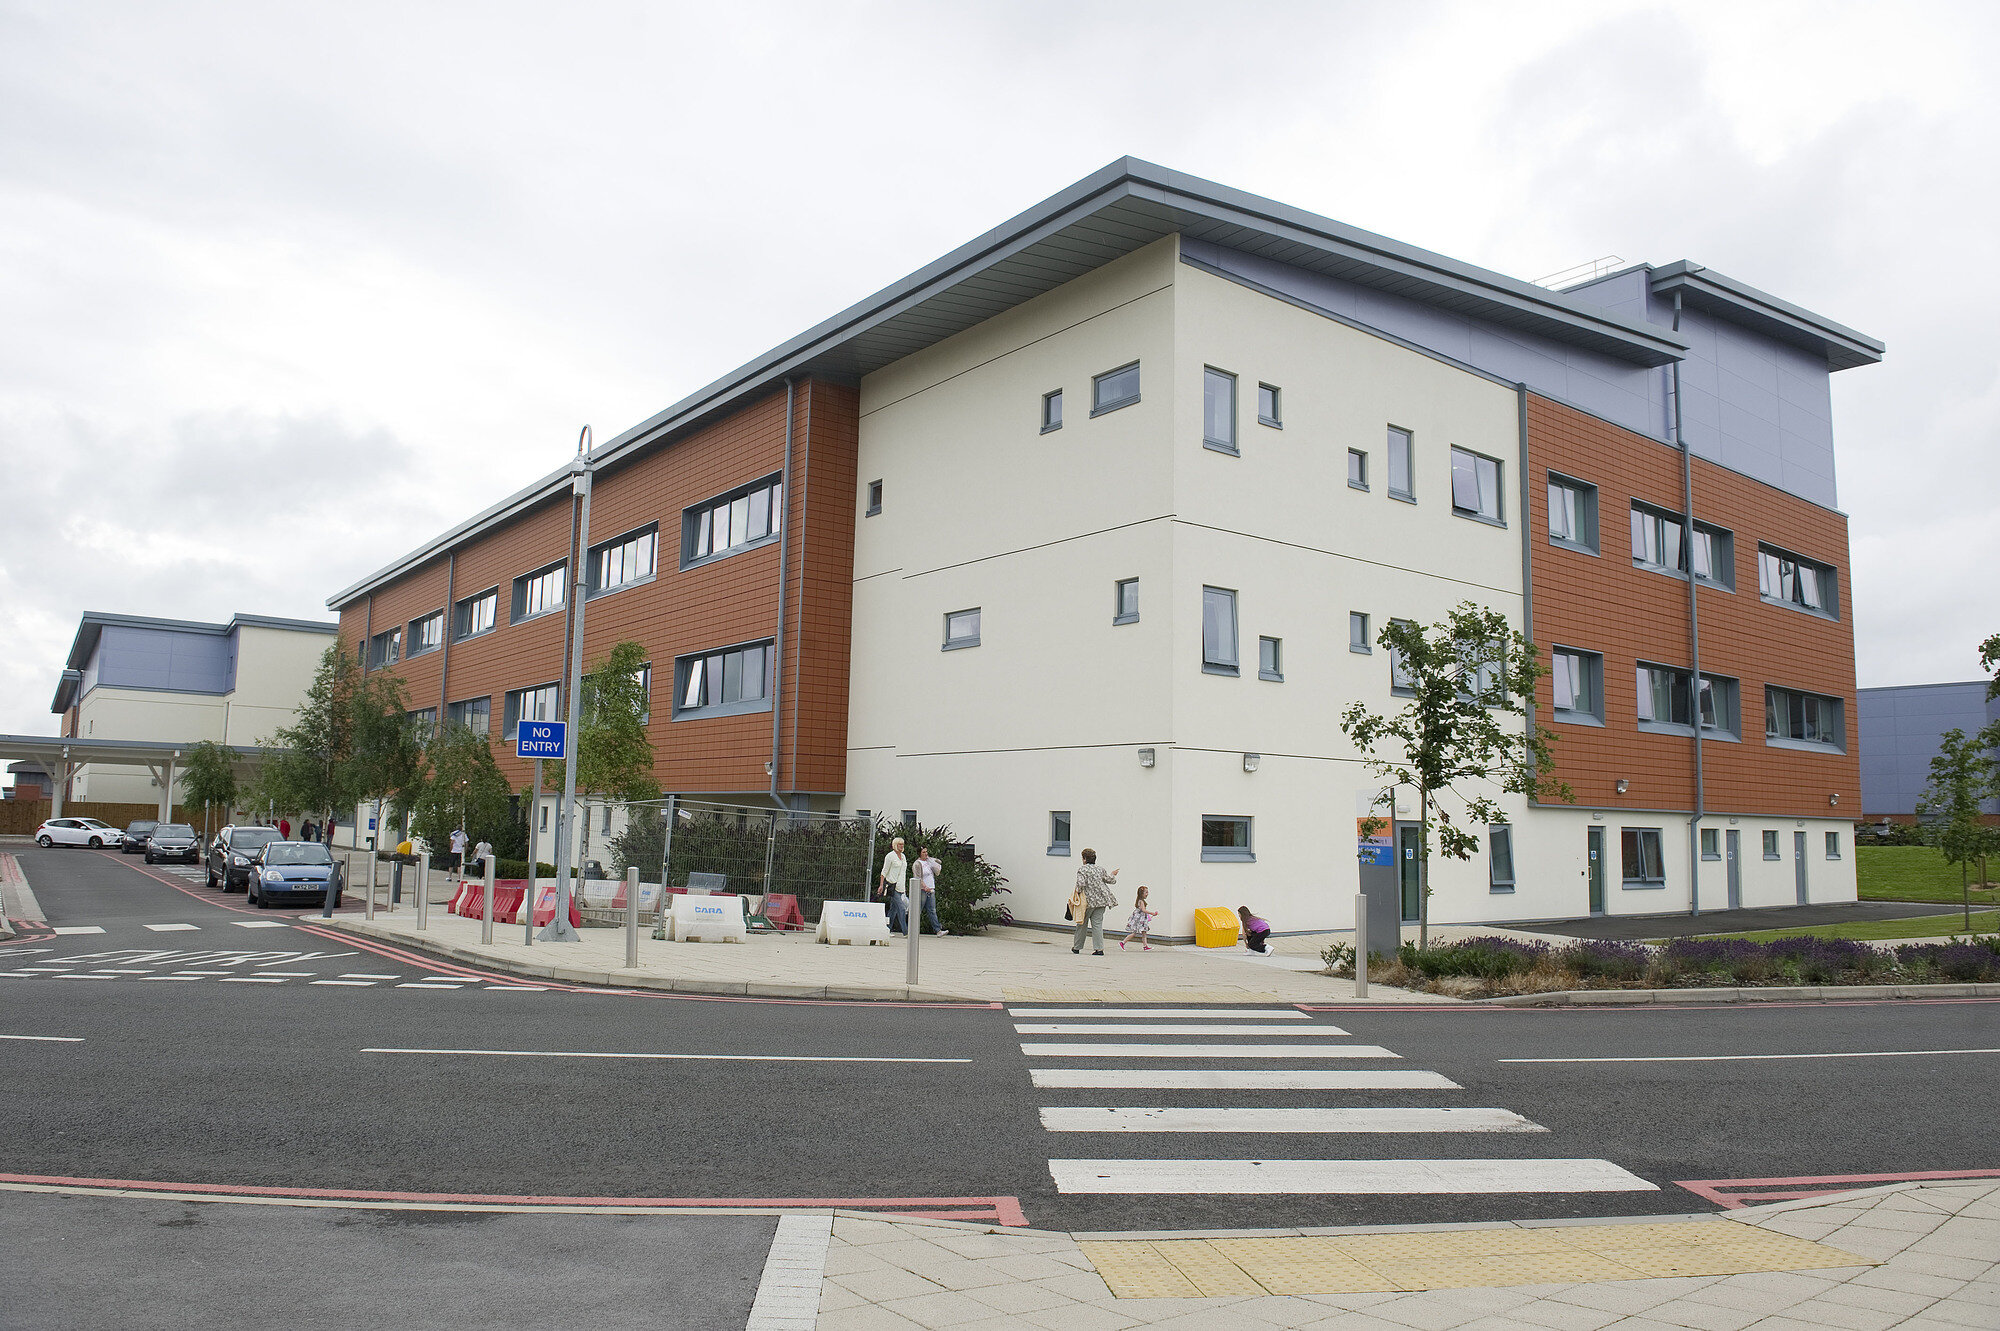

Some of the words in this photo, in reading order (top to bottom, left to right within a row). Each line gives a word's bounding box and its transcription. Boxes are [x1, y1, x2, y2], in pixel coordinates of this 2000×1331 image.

[532, 727, 551, 738] NO
[521, 740, 561, 752] ENTRY
[694, 906, 723, 914] CARA
[843, 910, 868, 918] CARA
[35, 949, 361, 967] ENTRY
